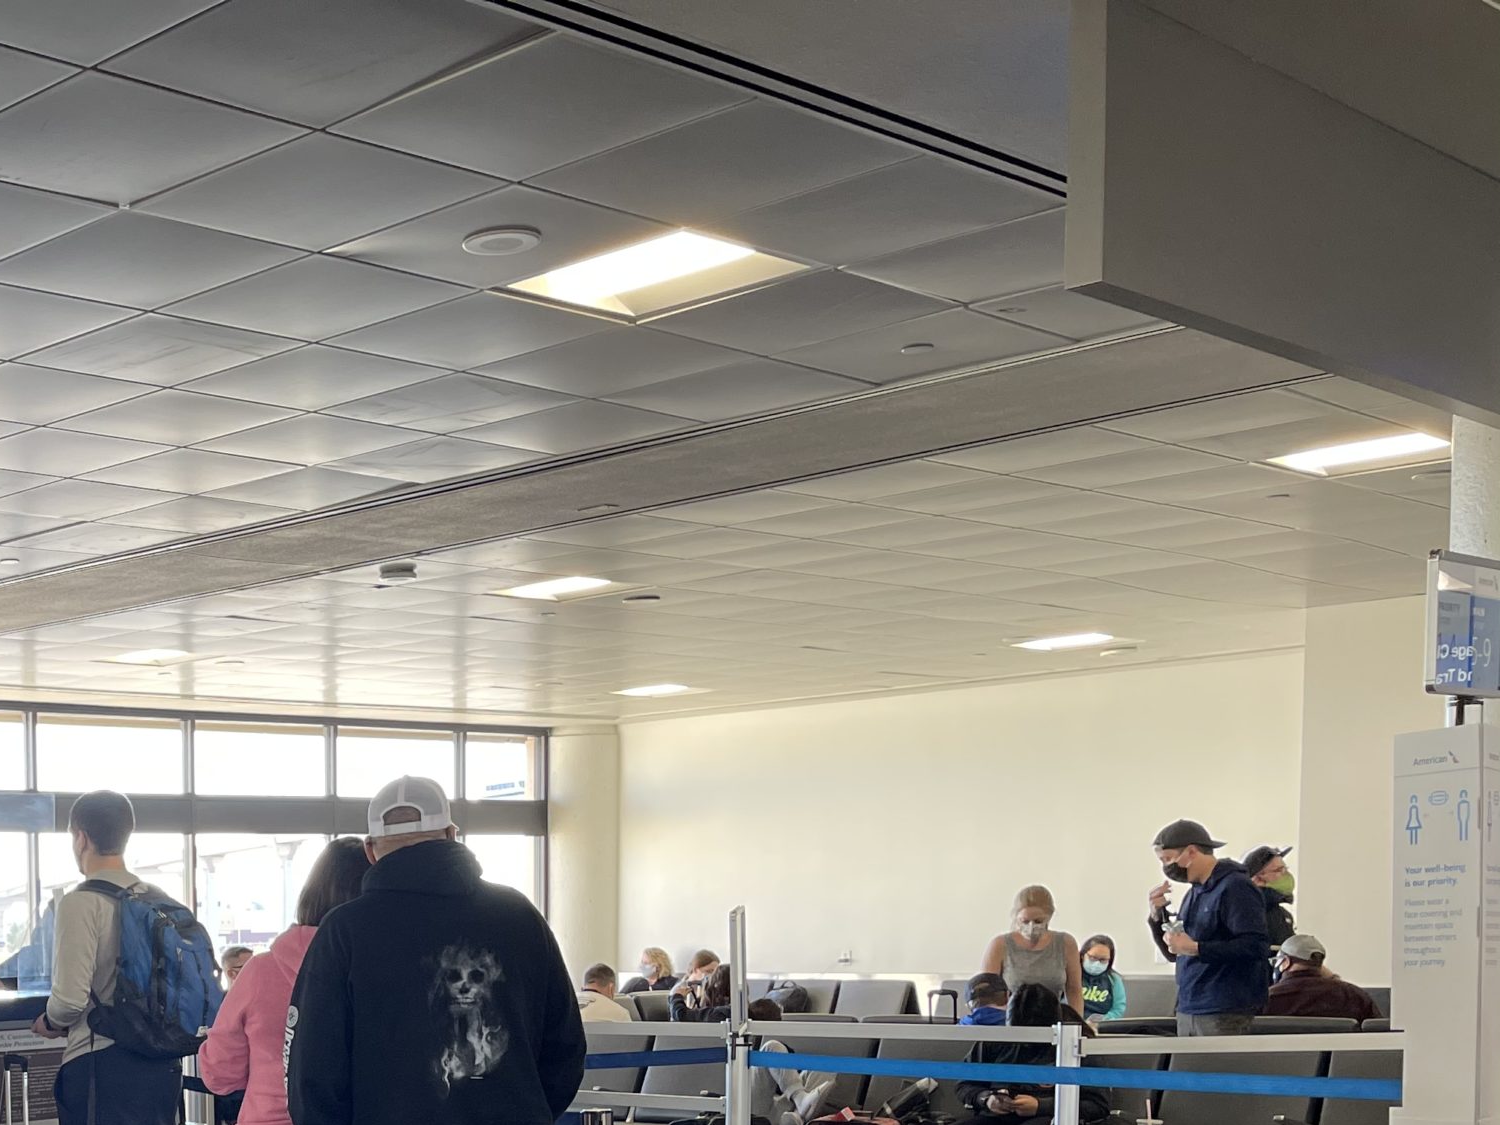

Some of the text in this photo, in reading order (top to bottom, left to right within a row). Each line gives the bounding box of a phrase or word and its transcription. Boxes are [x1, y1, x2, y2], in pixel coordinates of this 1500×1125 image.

[1413, 754, 1448, 767] American
[1405, 864, 1466, 875] Your well-being
[1404, 879, 1411, 887] is
[1412, 879, 1425, 887] our
